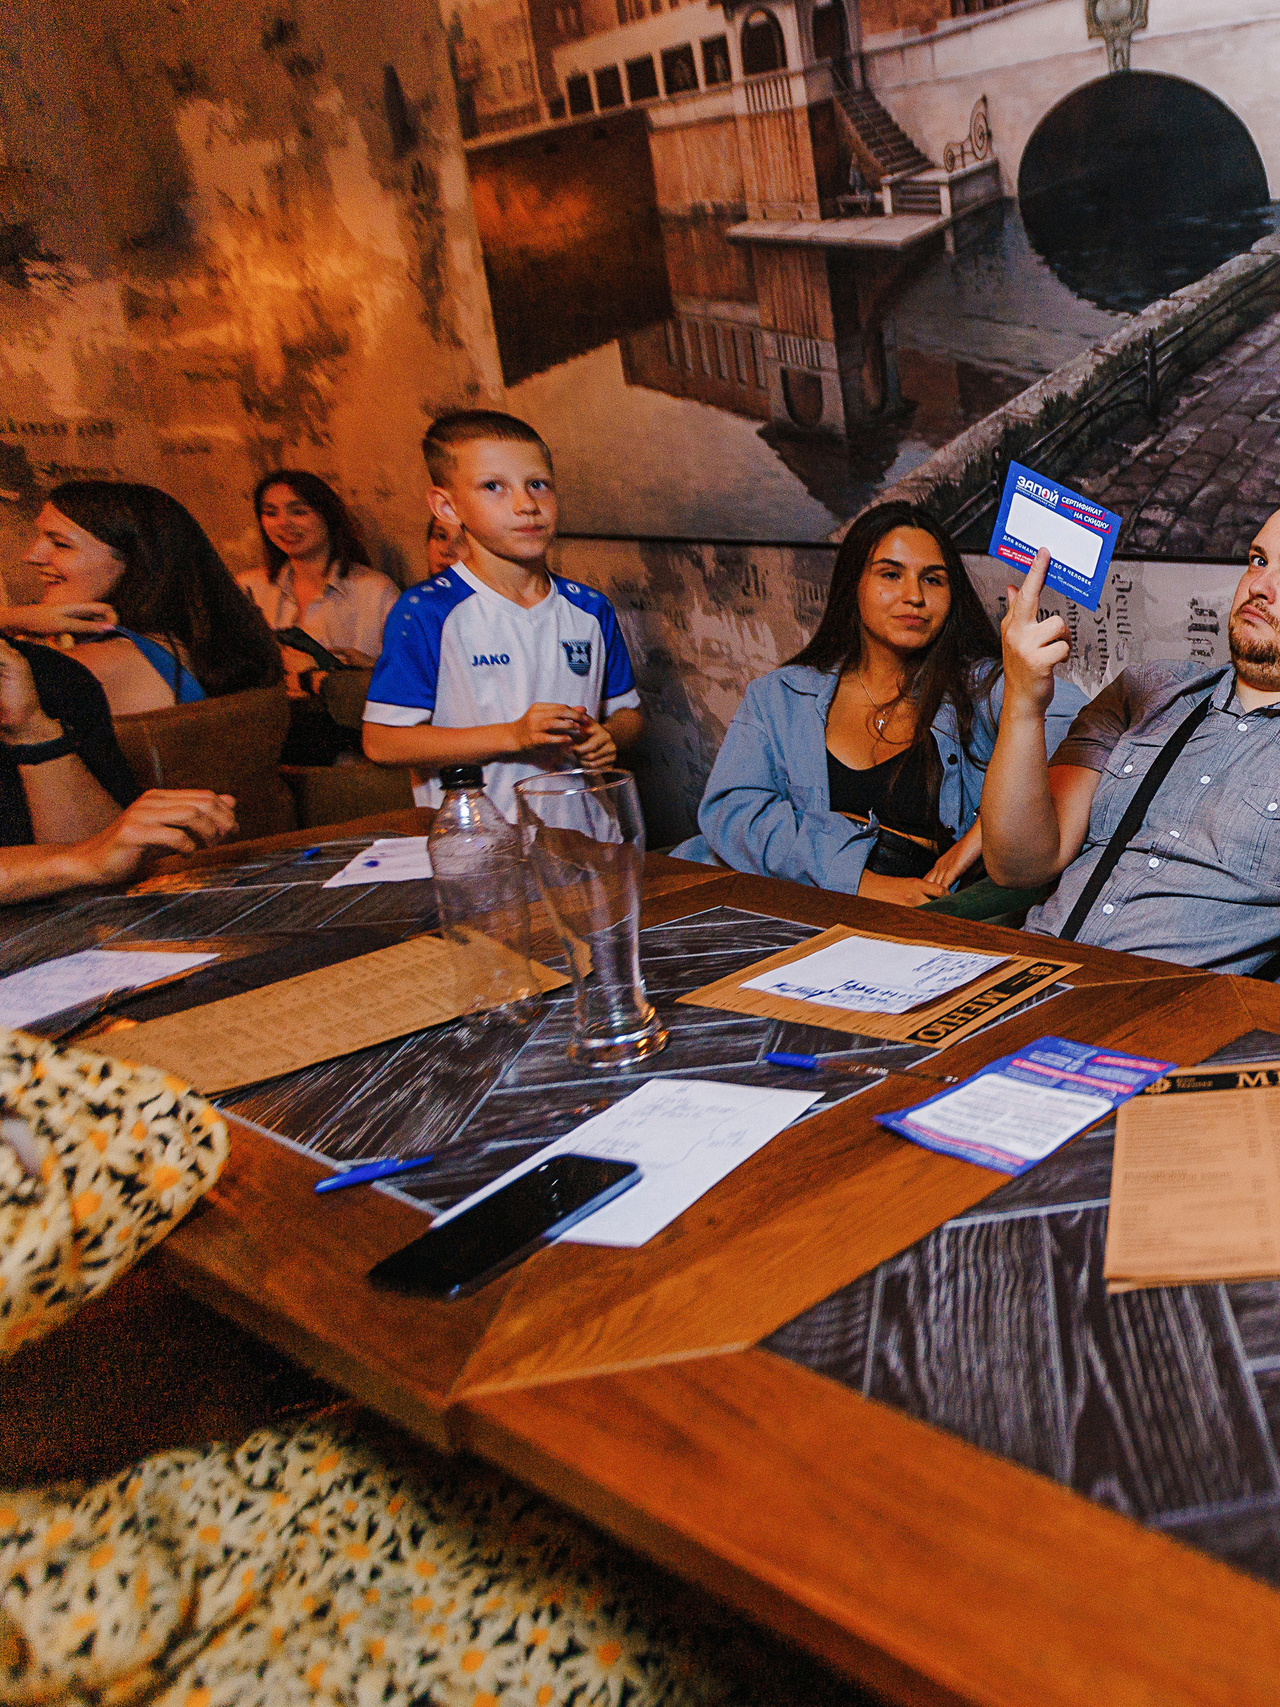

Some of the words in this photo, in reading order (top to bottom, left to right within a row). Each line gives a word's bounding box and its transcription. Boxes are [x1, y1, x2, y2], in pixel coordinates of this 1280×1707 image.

[1016, 475, 1059, 505] ЗАПОЙ
[1061, 496, 1102, 516] СЕРТИФИКАТ
[1073, 511, 1083, 520] НА
[1083, 515, 1109, 530] СКИДКУ
[1002, 534, 1015, 544] ДЛЯ
[1053, 562, 1063, 570] ДО
[1067, 569, 1092, 586] ЧЕЛОВЕК
[471, 653, 510, 667] JAKO
[916, 990, 1012, 1041] МЕНЮ
